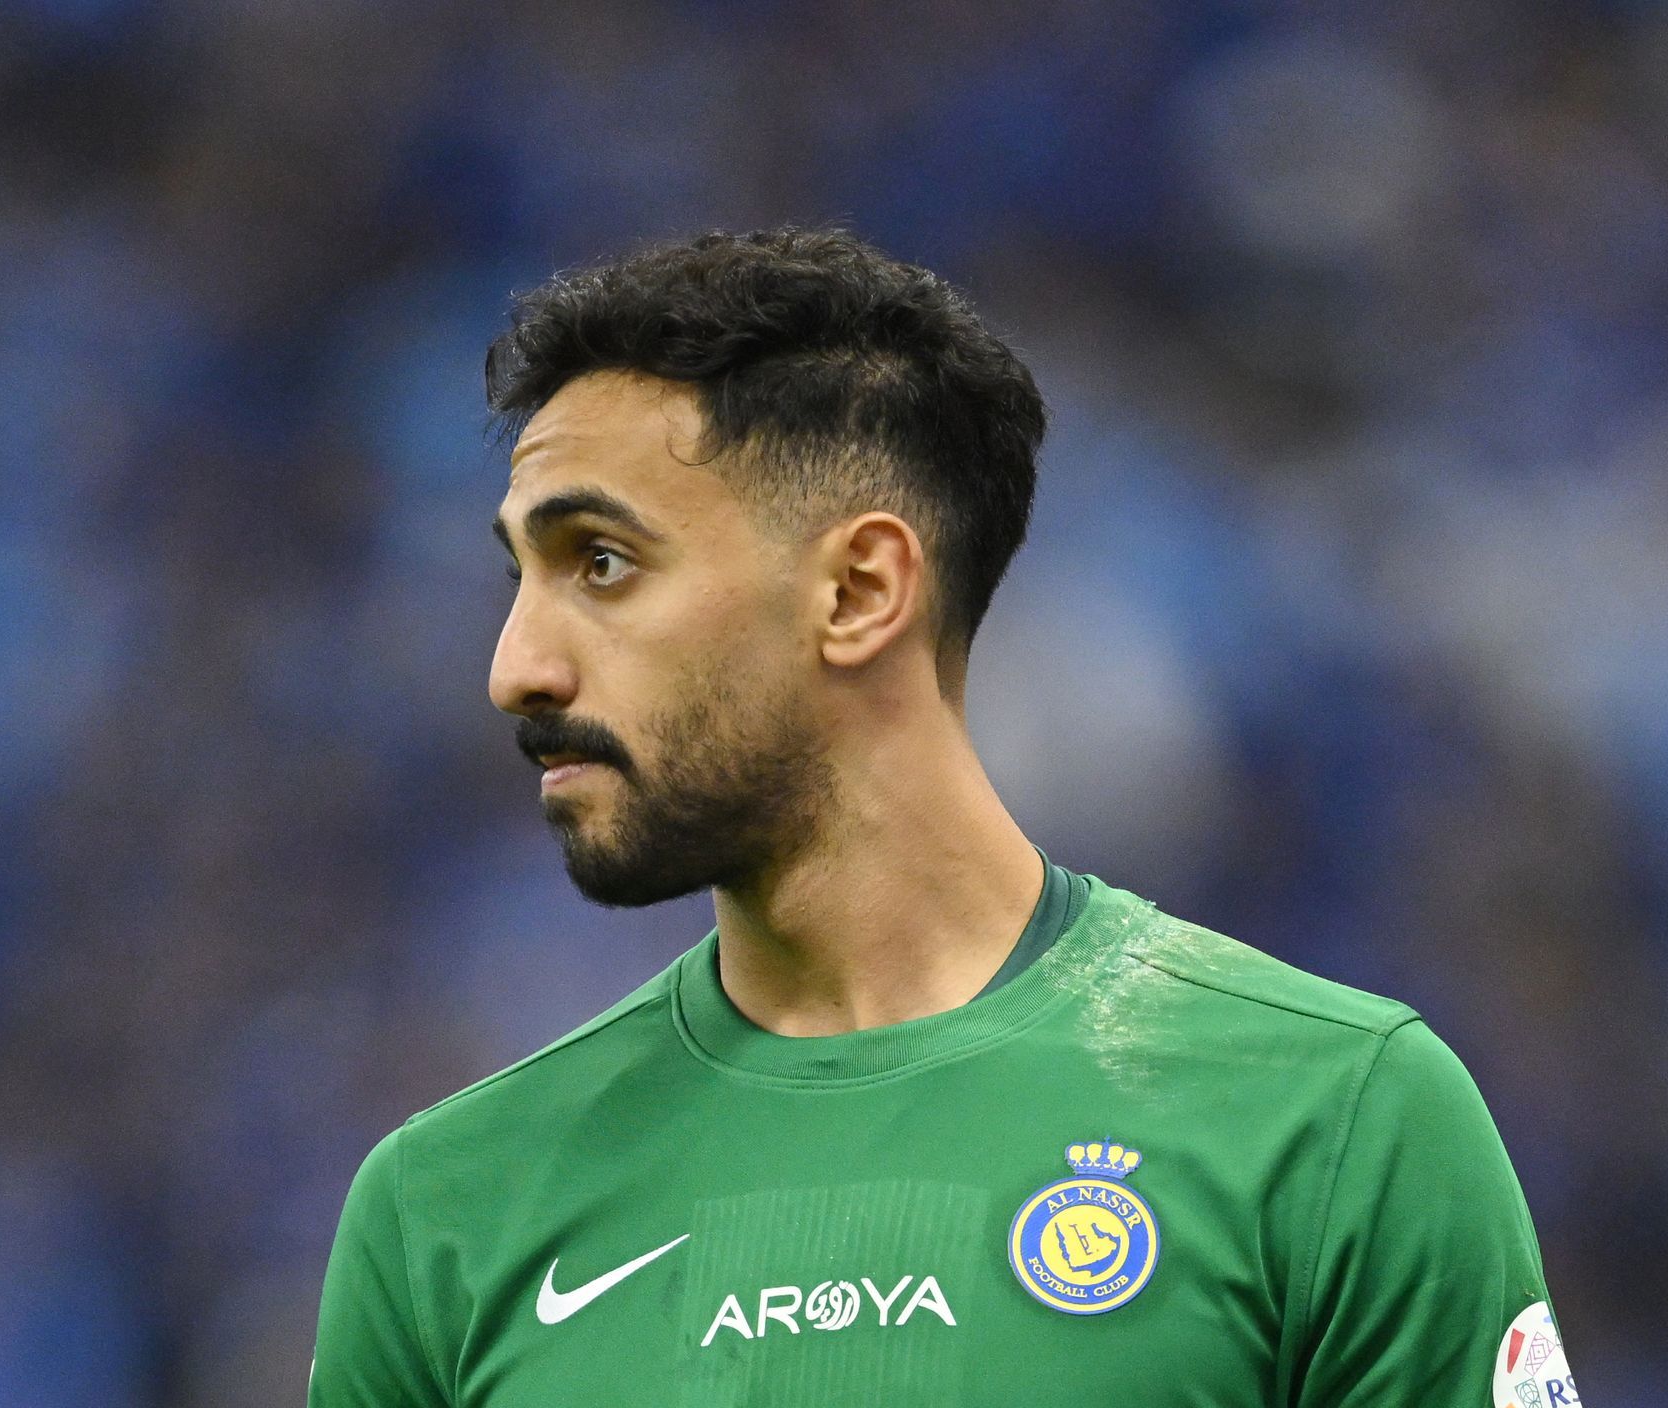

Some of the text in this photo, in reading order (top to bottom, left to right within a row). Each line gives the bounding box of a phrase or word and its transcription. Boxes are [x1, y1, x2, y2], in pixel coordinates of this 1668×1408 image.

[1046, 1187, 1143, 1230] AL NASSR
[1028, 1256, 1129, 1298] FOOTBALL CLUB
